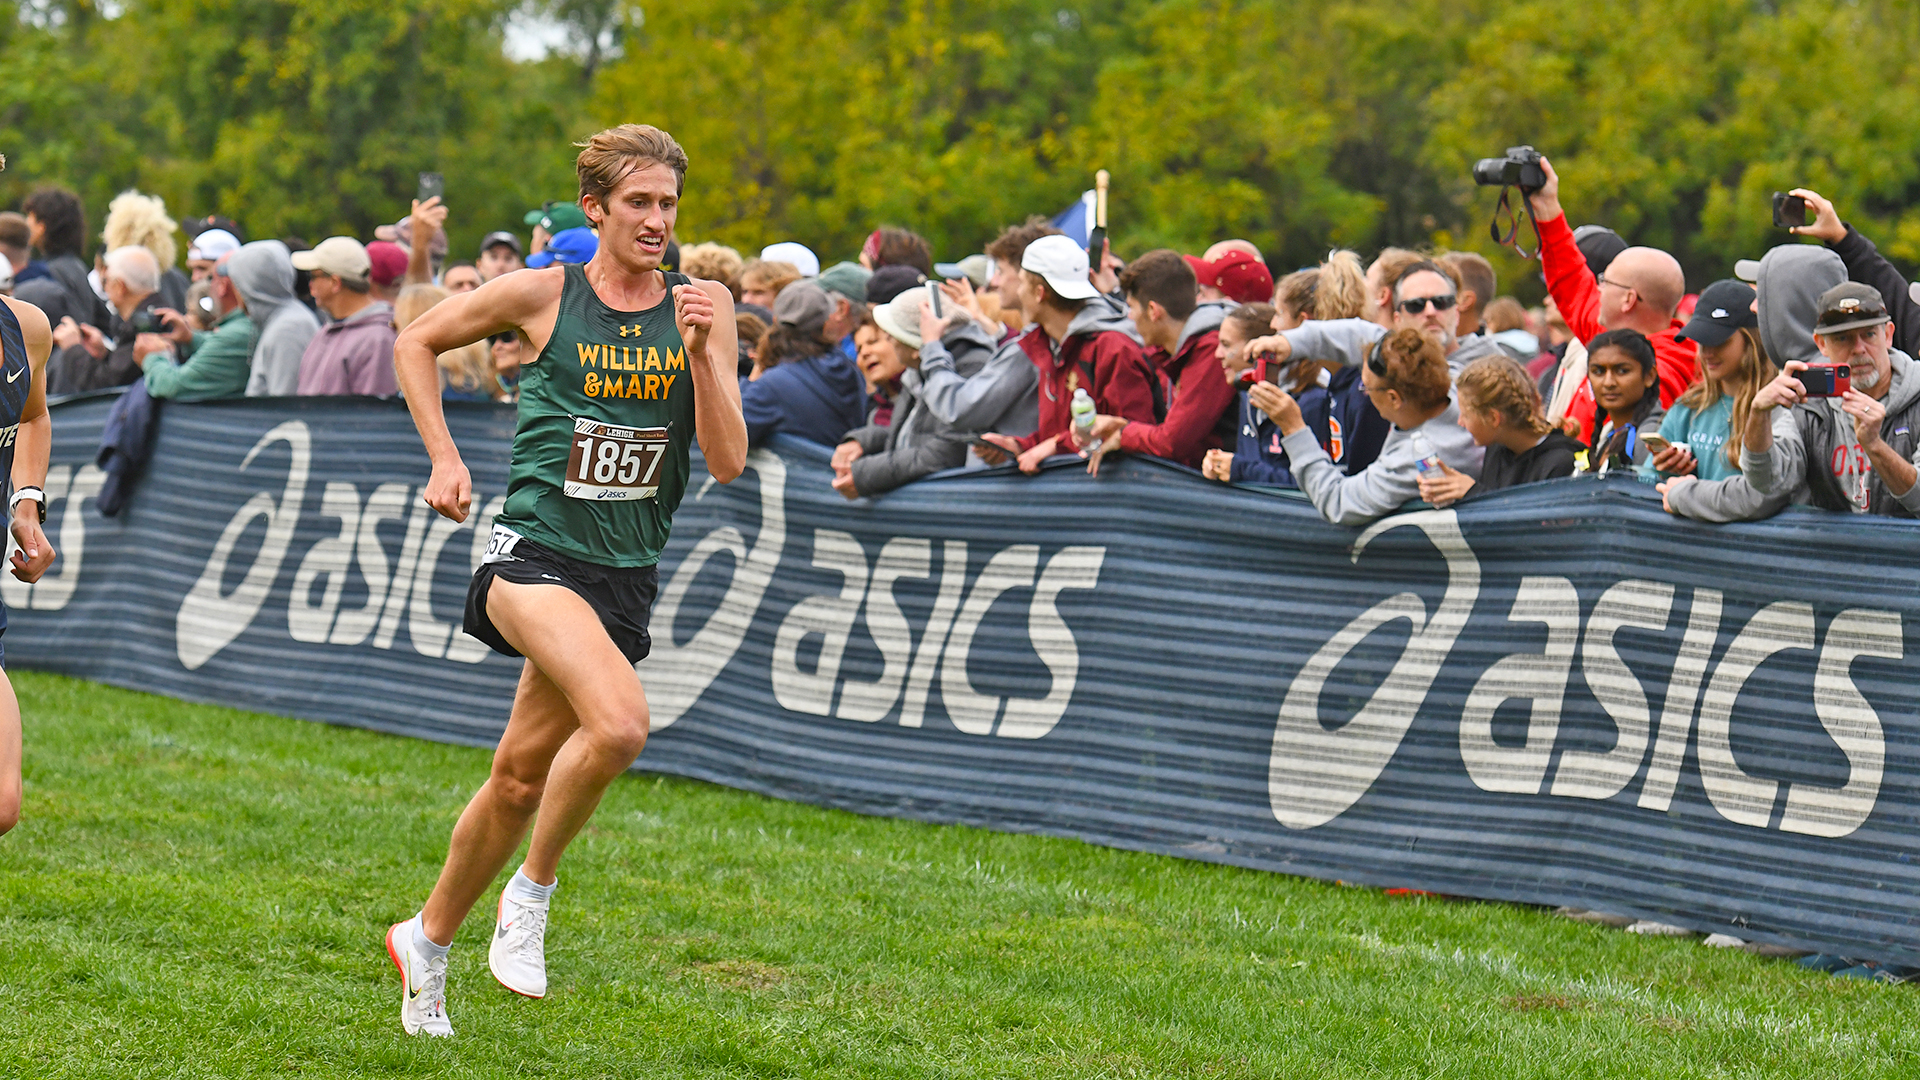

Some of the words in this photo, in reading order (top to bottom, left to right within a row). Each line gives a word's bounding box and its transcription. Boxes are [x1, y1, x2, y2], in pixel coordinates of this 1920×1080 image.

[576, 342, 685, 371] WILLIAM
[583, 371, 676, 400] &MARY
[606, 428, 634, 438] LEHIGH
[577, 437, 666, 484] 1857
